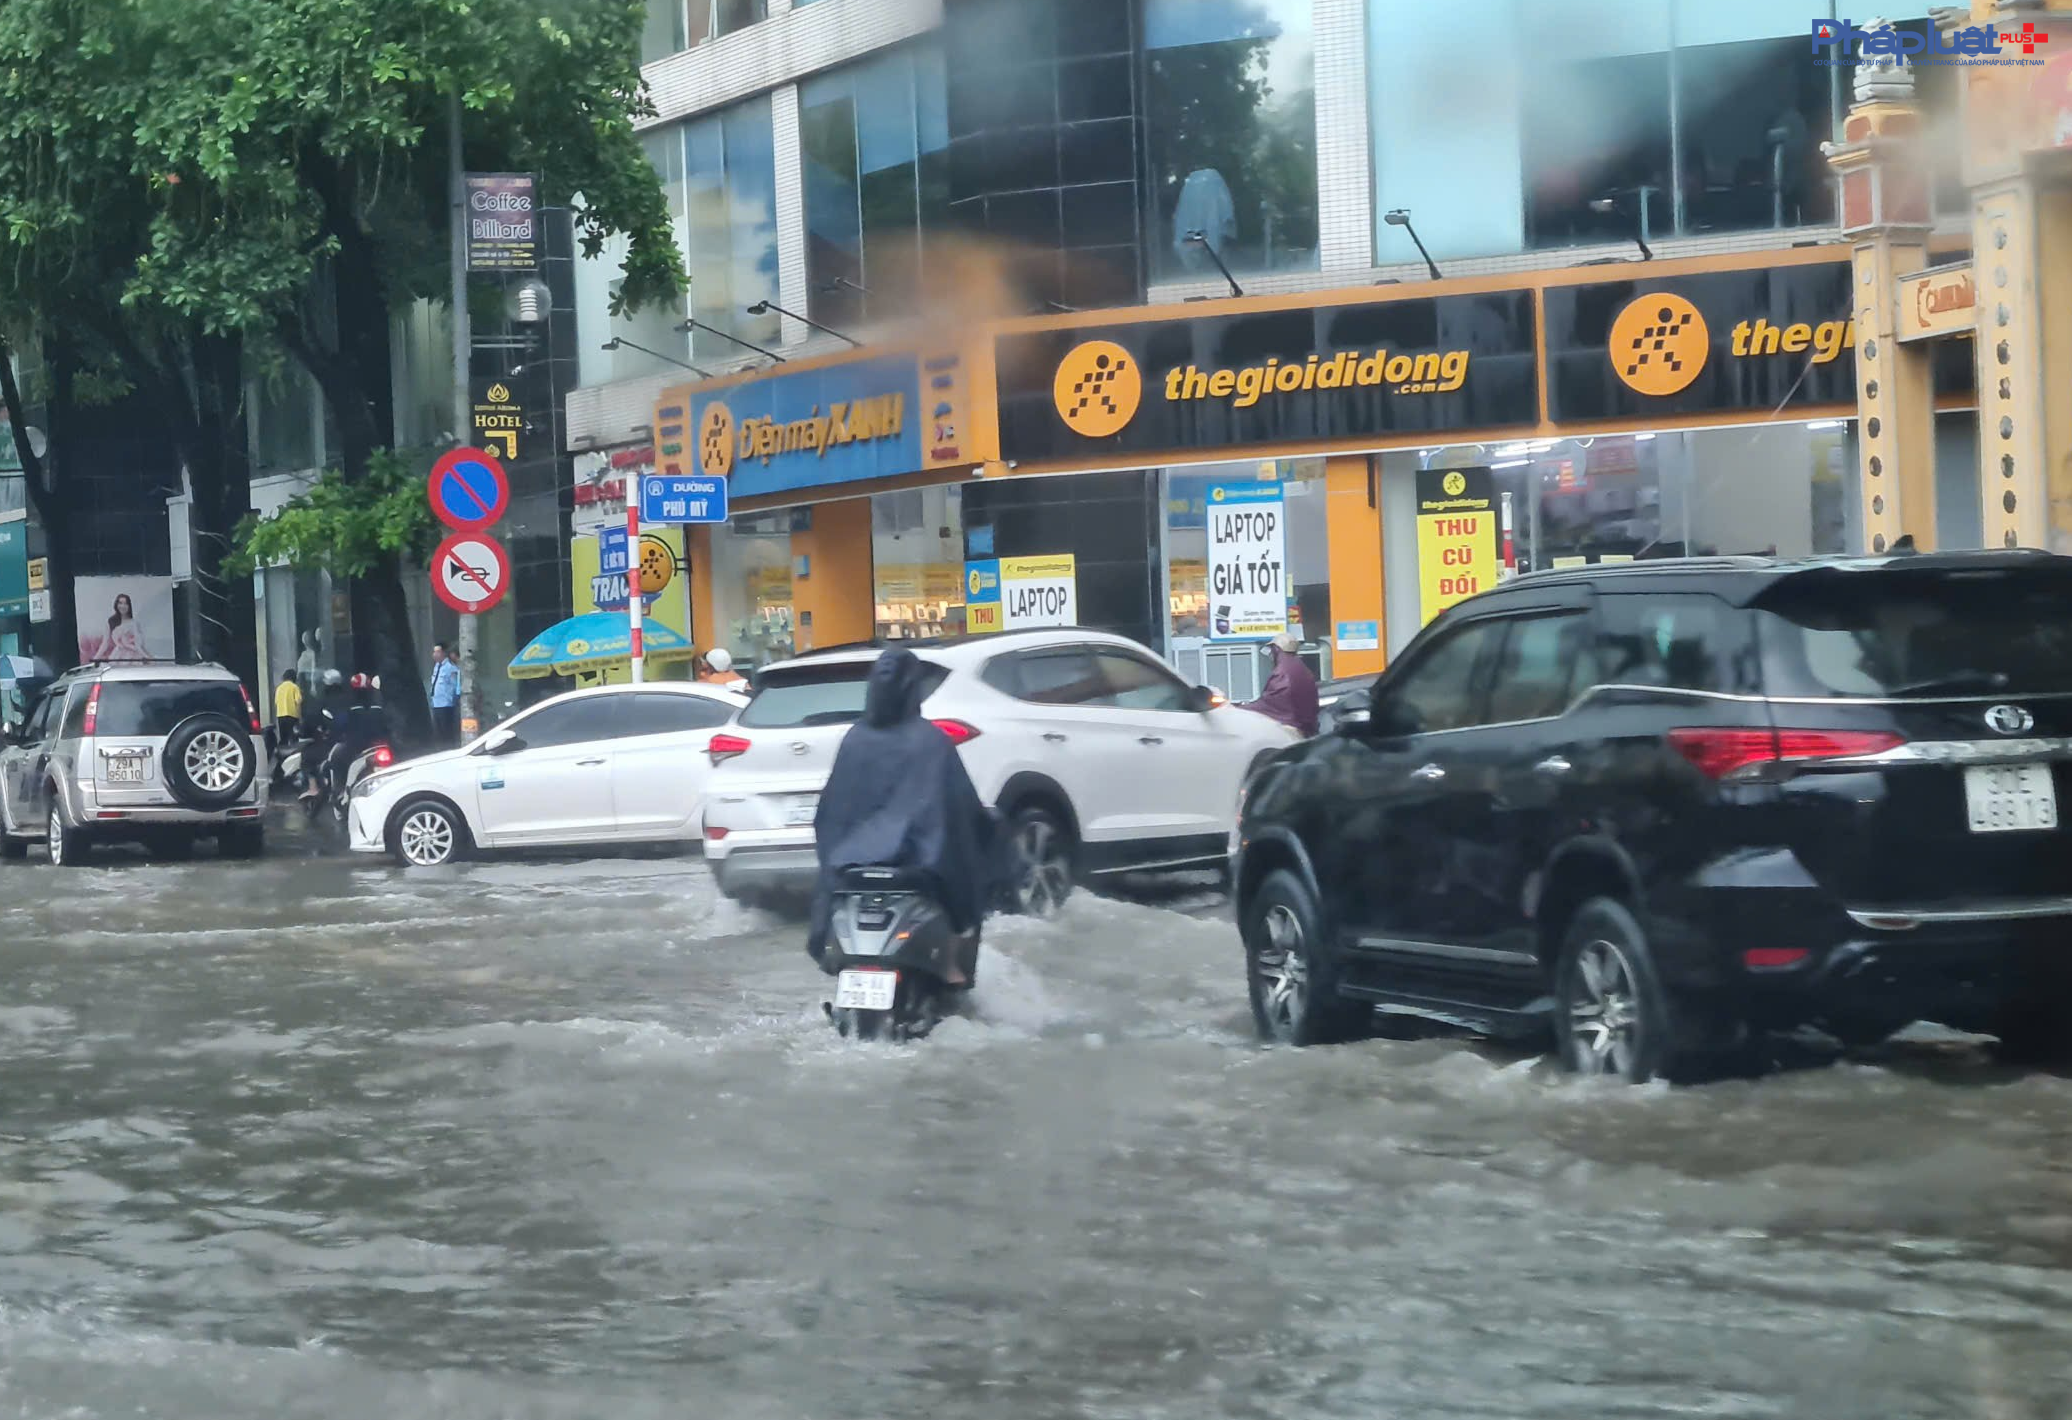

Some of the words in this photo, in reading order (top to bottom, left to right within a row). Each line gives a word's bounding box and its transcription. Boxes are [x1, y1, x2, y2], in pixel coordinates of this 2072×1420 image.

[471, 191, 532, 211] Coffee
[473, 218, 532, 239] Billiard
[1164, 349, 1469, 408] thegioididong
[475, 414, 523, 428] HOTEL
[828, 392, 904, 445] XANH
[1215, 512, 1276, 543] LAPTOP
[1434, 518, 1477, 536] THU
[1443, 544, 1472, 566] CŨ
[1214, 554, 1244, 596] GIÁ
[1247, 549, 1281, 595] TỐT
[1009, 586, 1067, 618] LAPTOP
[974, 607, 994, 624] THU
